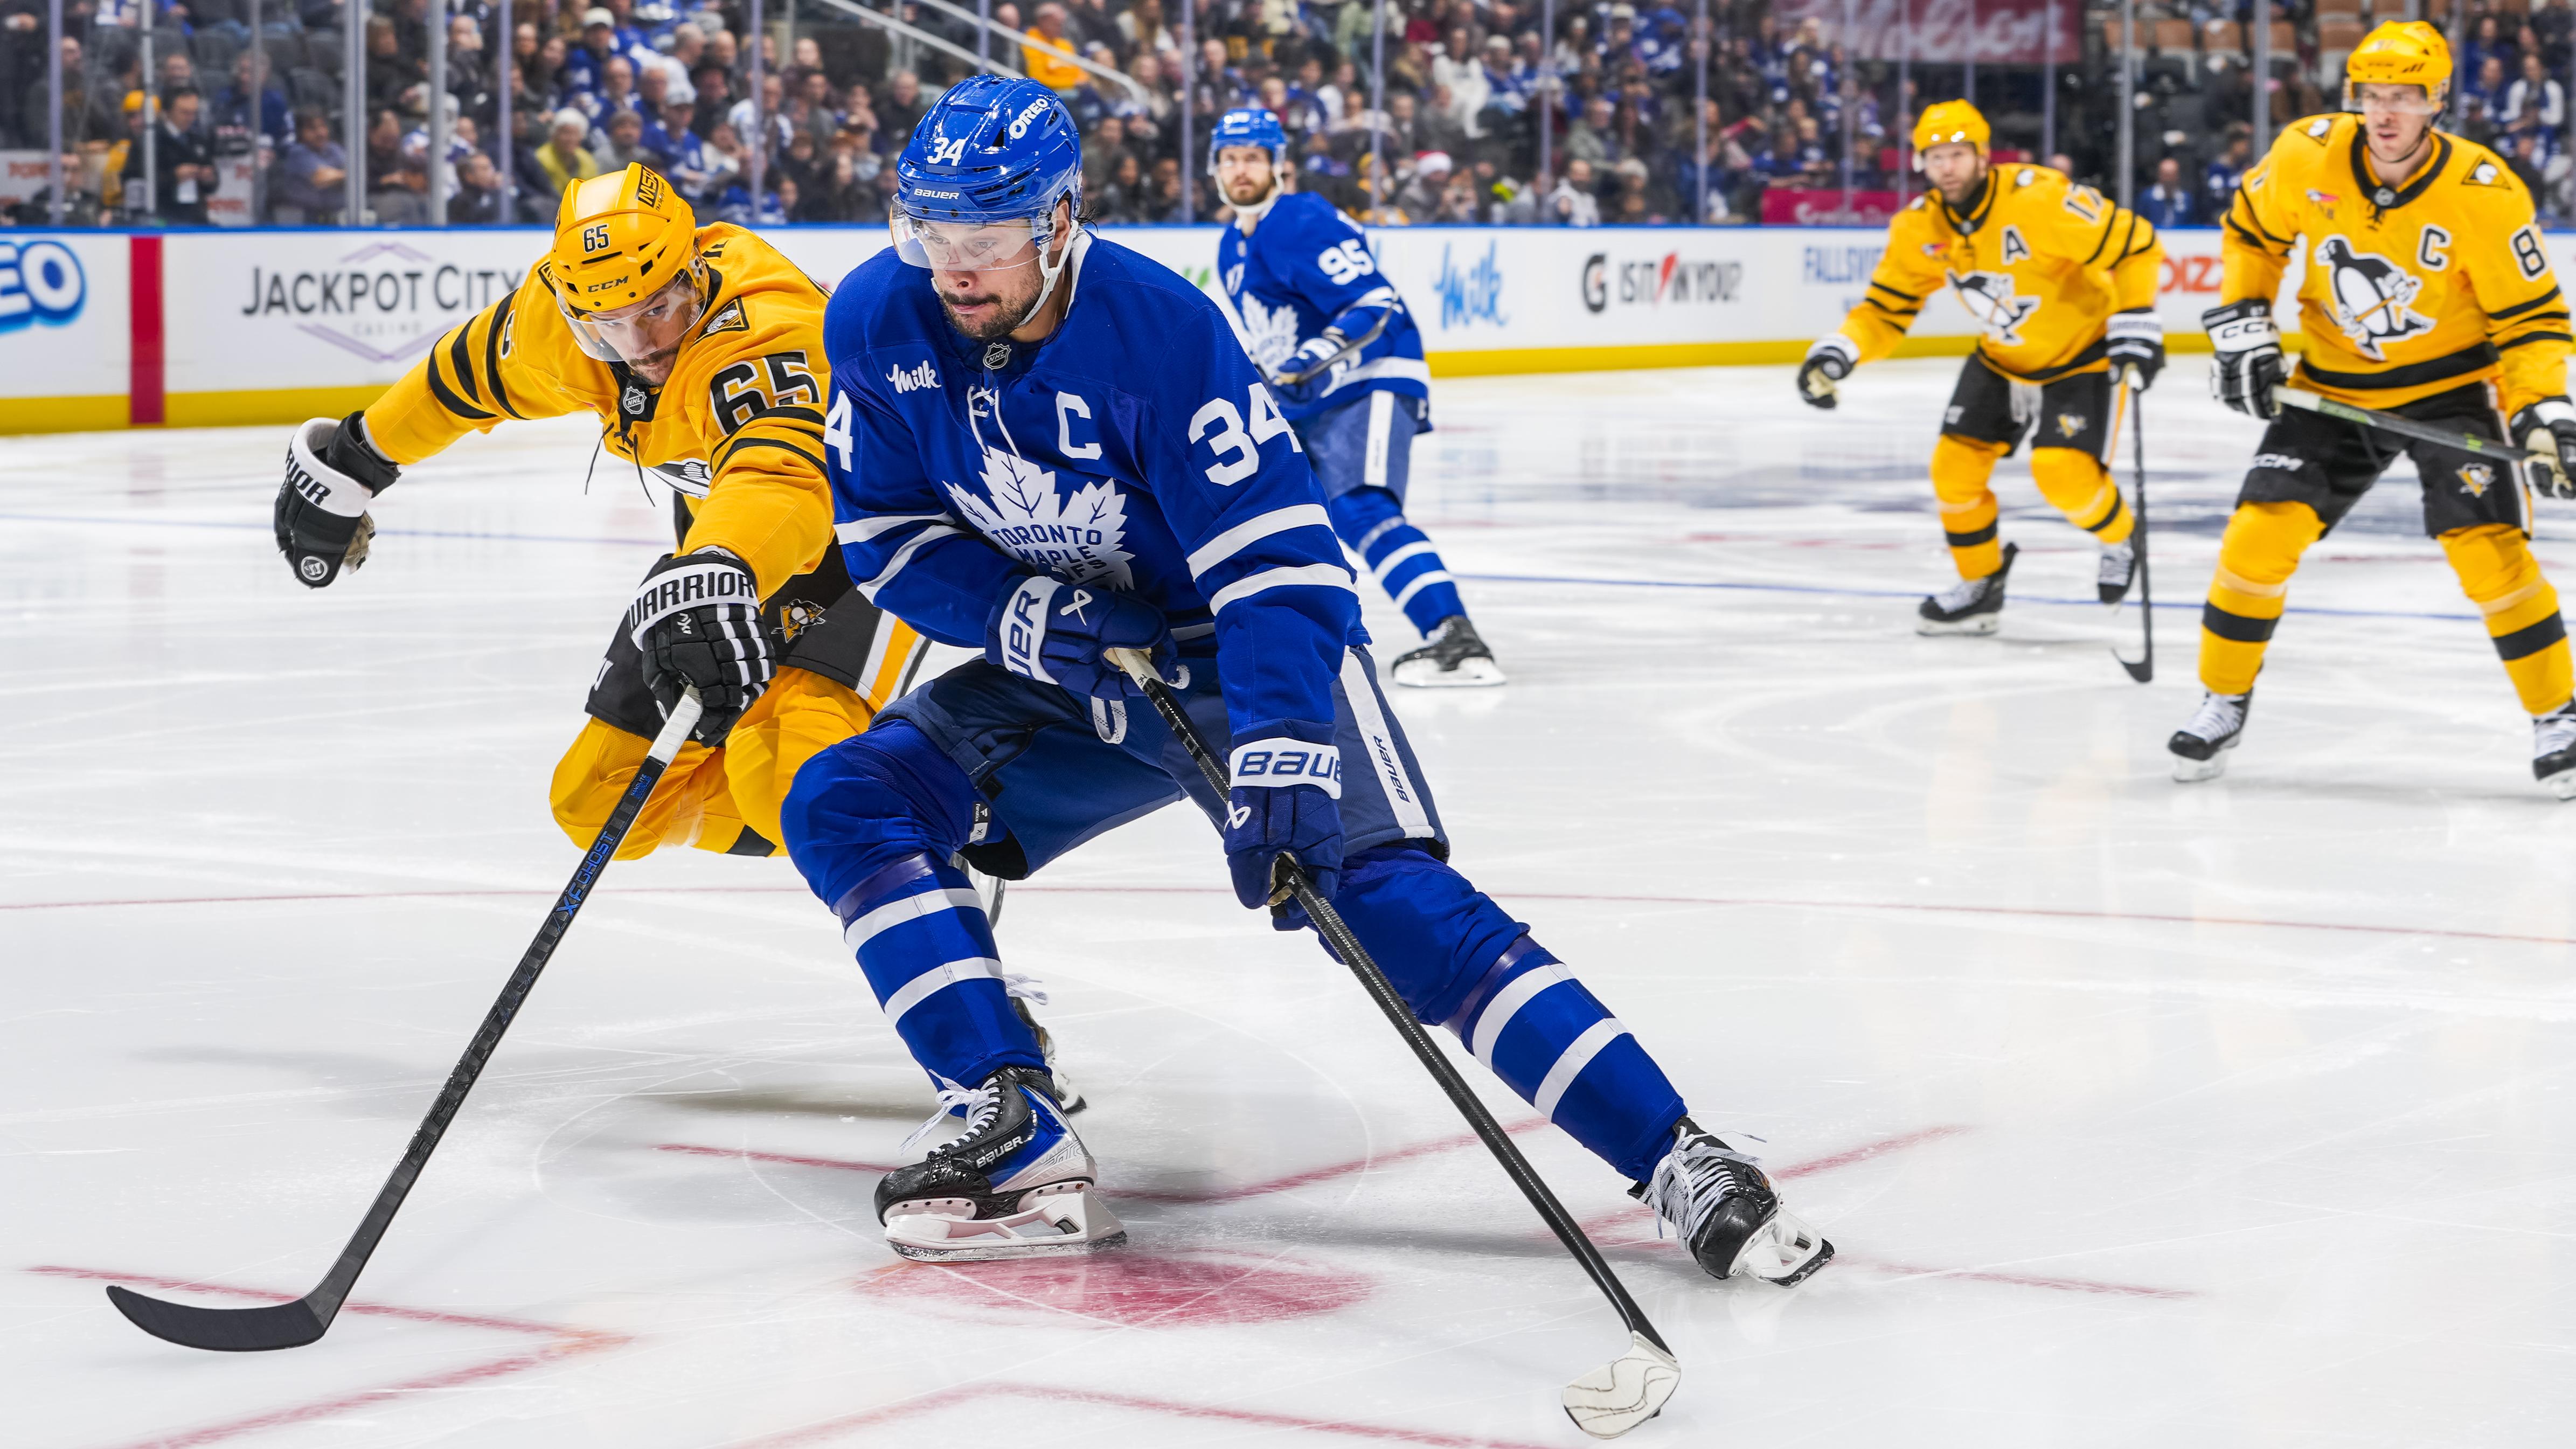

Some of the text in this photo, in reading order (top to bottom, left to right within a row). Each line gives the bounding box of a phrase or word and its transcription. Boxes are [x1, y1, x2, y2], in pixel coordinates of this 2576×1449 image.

[1009, 97, 1049, 140] OREO
[927, 136, 968, 167] 34
[914, 188, 960, 200] BAUER
[583, 224, 610, 253] 65
[2002, 225, 2030, 265] A
[2418, 223, 2452, 271] C
[1318, 238, 1374, 286] 95
[1620, 261, 1635, 303] IS
[1637, 261, 1656, 303] IT
[242, 266, 423, 316] JACKPOT
[587, 276, 629, 293] CCM
[352, 322, 422, 337] CASINO
[887, 359, 942, 394] Milk
[989, 352, 1005, 363] NHL
[625, 396, 642, 407] NHL
[710, 349, 821, 435] 65
[823, 390, 853, 473] 4
[1056, 391, 1102, 460] C
[1188, 382, 1302, 487] 34
[991, 524, 1102, 548] TORONTO
[1015, 545, 1097, 566] MAPLE
[629, 571, 754, 632] WARRIOR
[1373, 736, 1411, 803] BAUER
[577, 830, 614, 885] GHOST
[976, 1135, 1025, 1169] BAUER
